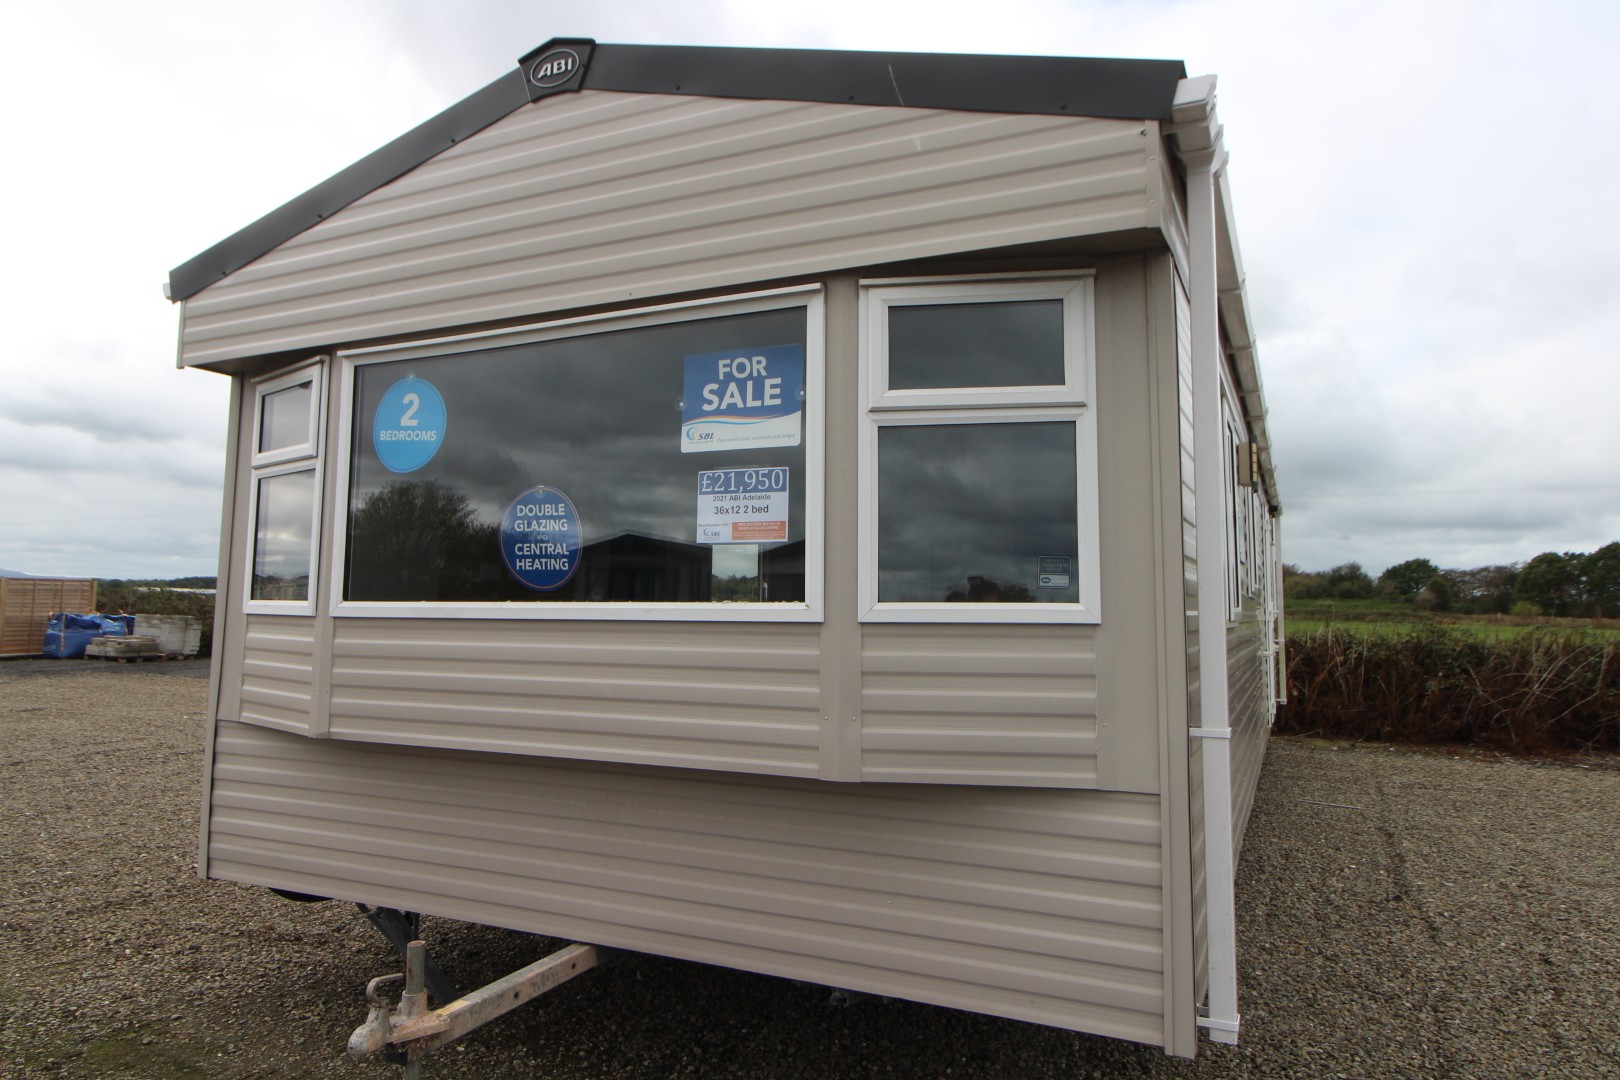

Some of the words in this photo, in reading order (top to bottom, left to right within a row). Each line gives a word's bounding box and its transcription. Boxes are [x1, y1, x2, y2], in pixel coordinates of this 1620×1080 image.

[537, 57, 573, 79] ABI
[718, 356, 767, 380] FOR
[702, 377, 782, 411] SALE
[400, 392, 420, 427] 2
[380, 430, 437, 441] BEDROOMS
[701, 469, 783, 493] £21,950
[516, 503, 565, 517] DOUBLE
[714, 505, 741, 515] 36x12
[743, 505, 749, 514] 2
[751, 504, 769, 514] bed
[514, 518, 568, 532] GLAZING
[514, 543, 570, 556] CENTRAL
[516, 558, 569, 570] HEATING
